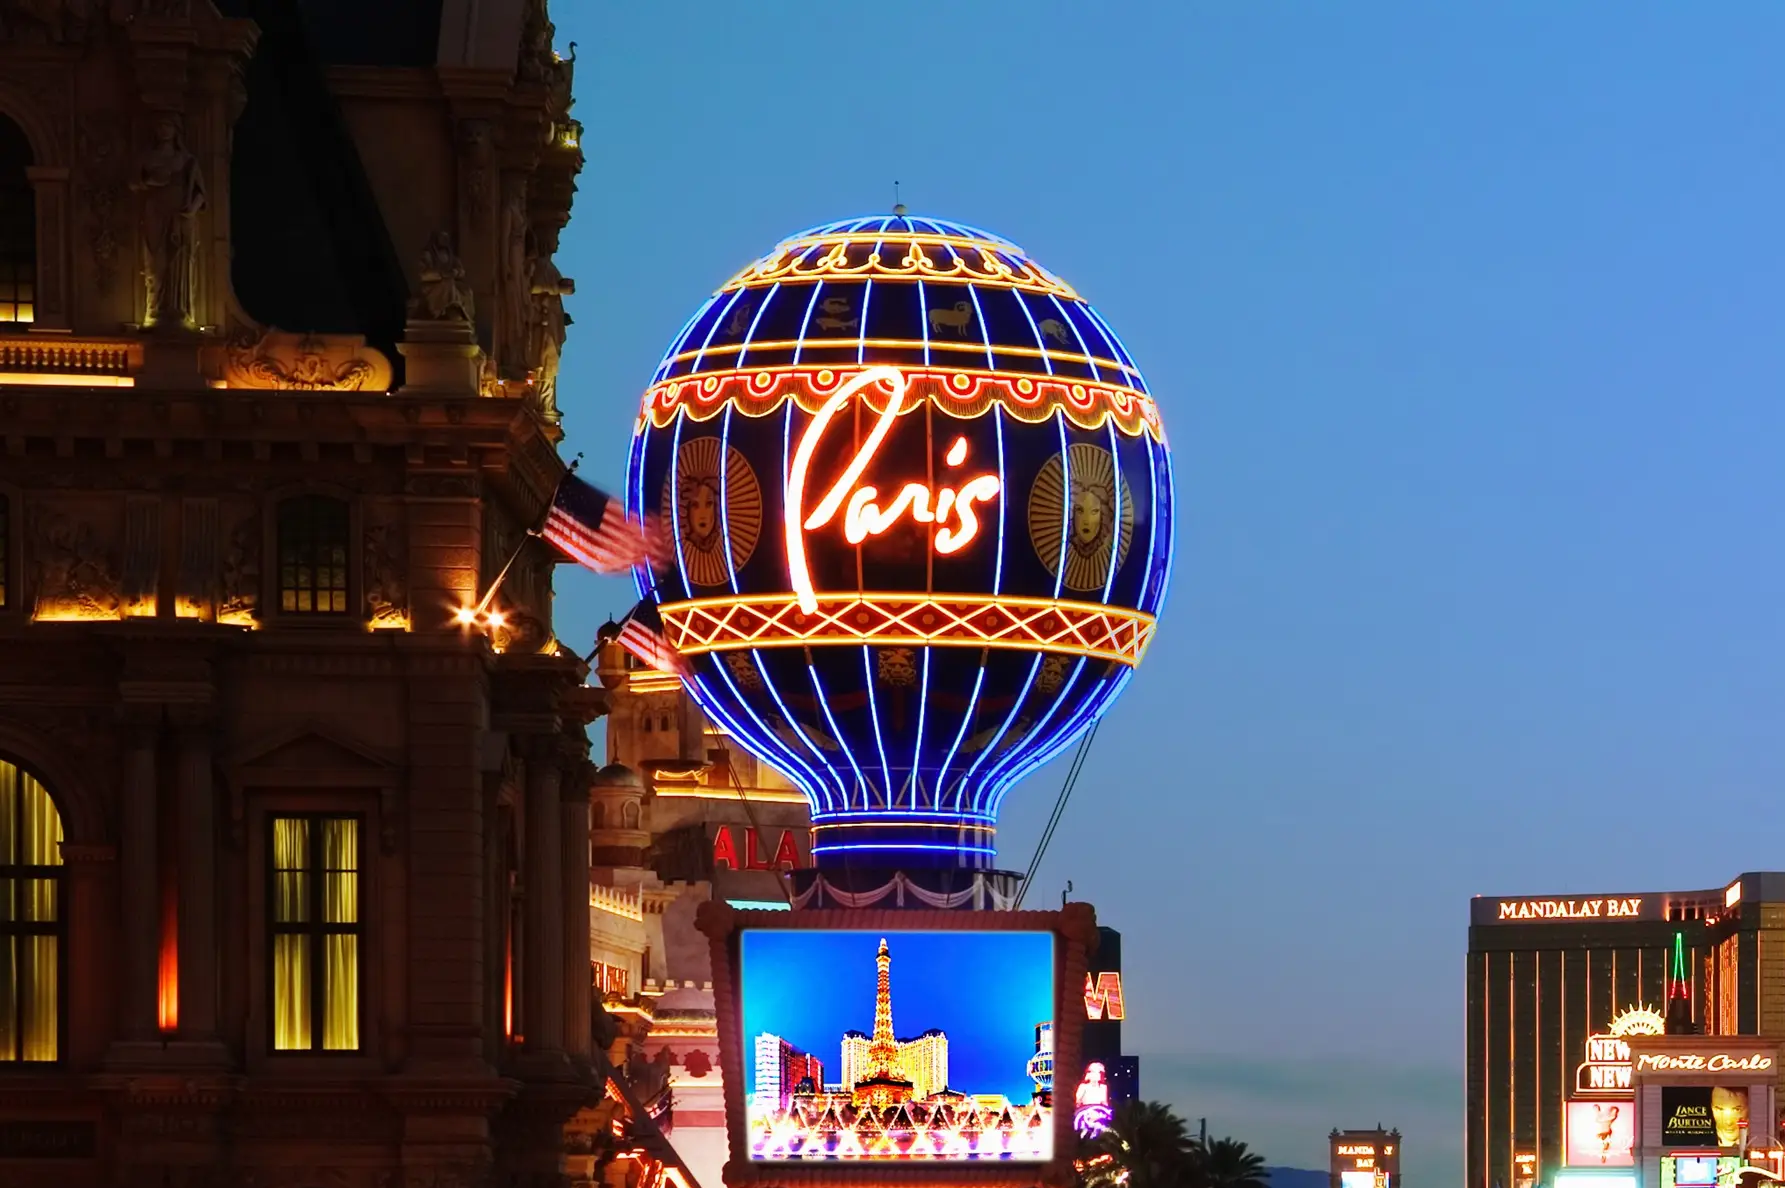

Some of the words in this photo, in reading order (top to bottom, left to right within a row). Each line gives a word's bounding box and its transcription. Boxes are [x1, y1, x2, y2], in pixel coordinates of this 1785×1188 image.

[785, 365, 1001, 616] Paris
[1499, 900, 1603, 919] MANDALAY
[1607, 899, 1641, 917] BAY
[1590, 1039, 1631, 1061] NEW
[1637, 1054, 1706, 1072] Monte
[1707, 1054, 1772, 1072] Carlo
[1590, 1066, 1632, 1088] NEW
[1675, 1105, 1707, 1117] LANCE
[1667, 1117, 1711, 1128] BURTON
[1356, 1159, 1375, 1168] BAY
